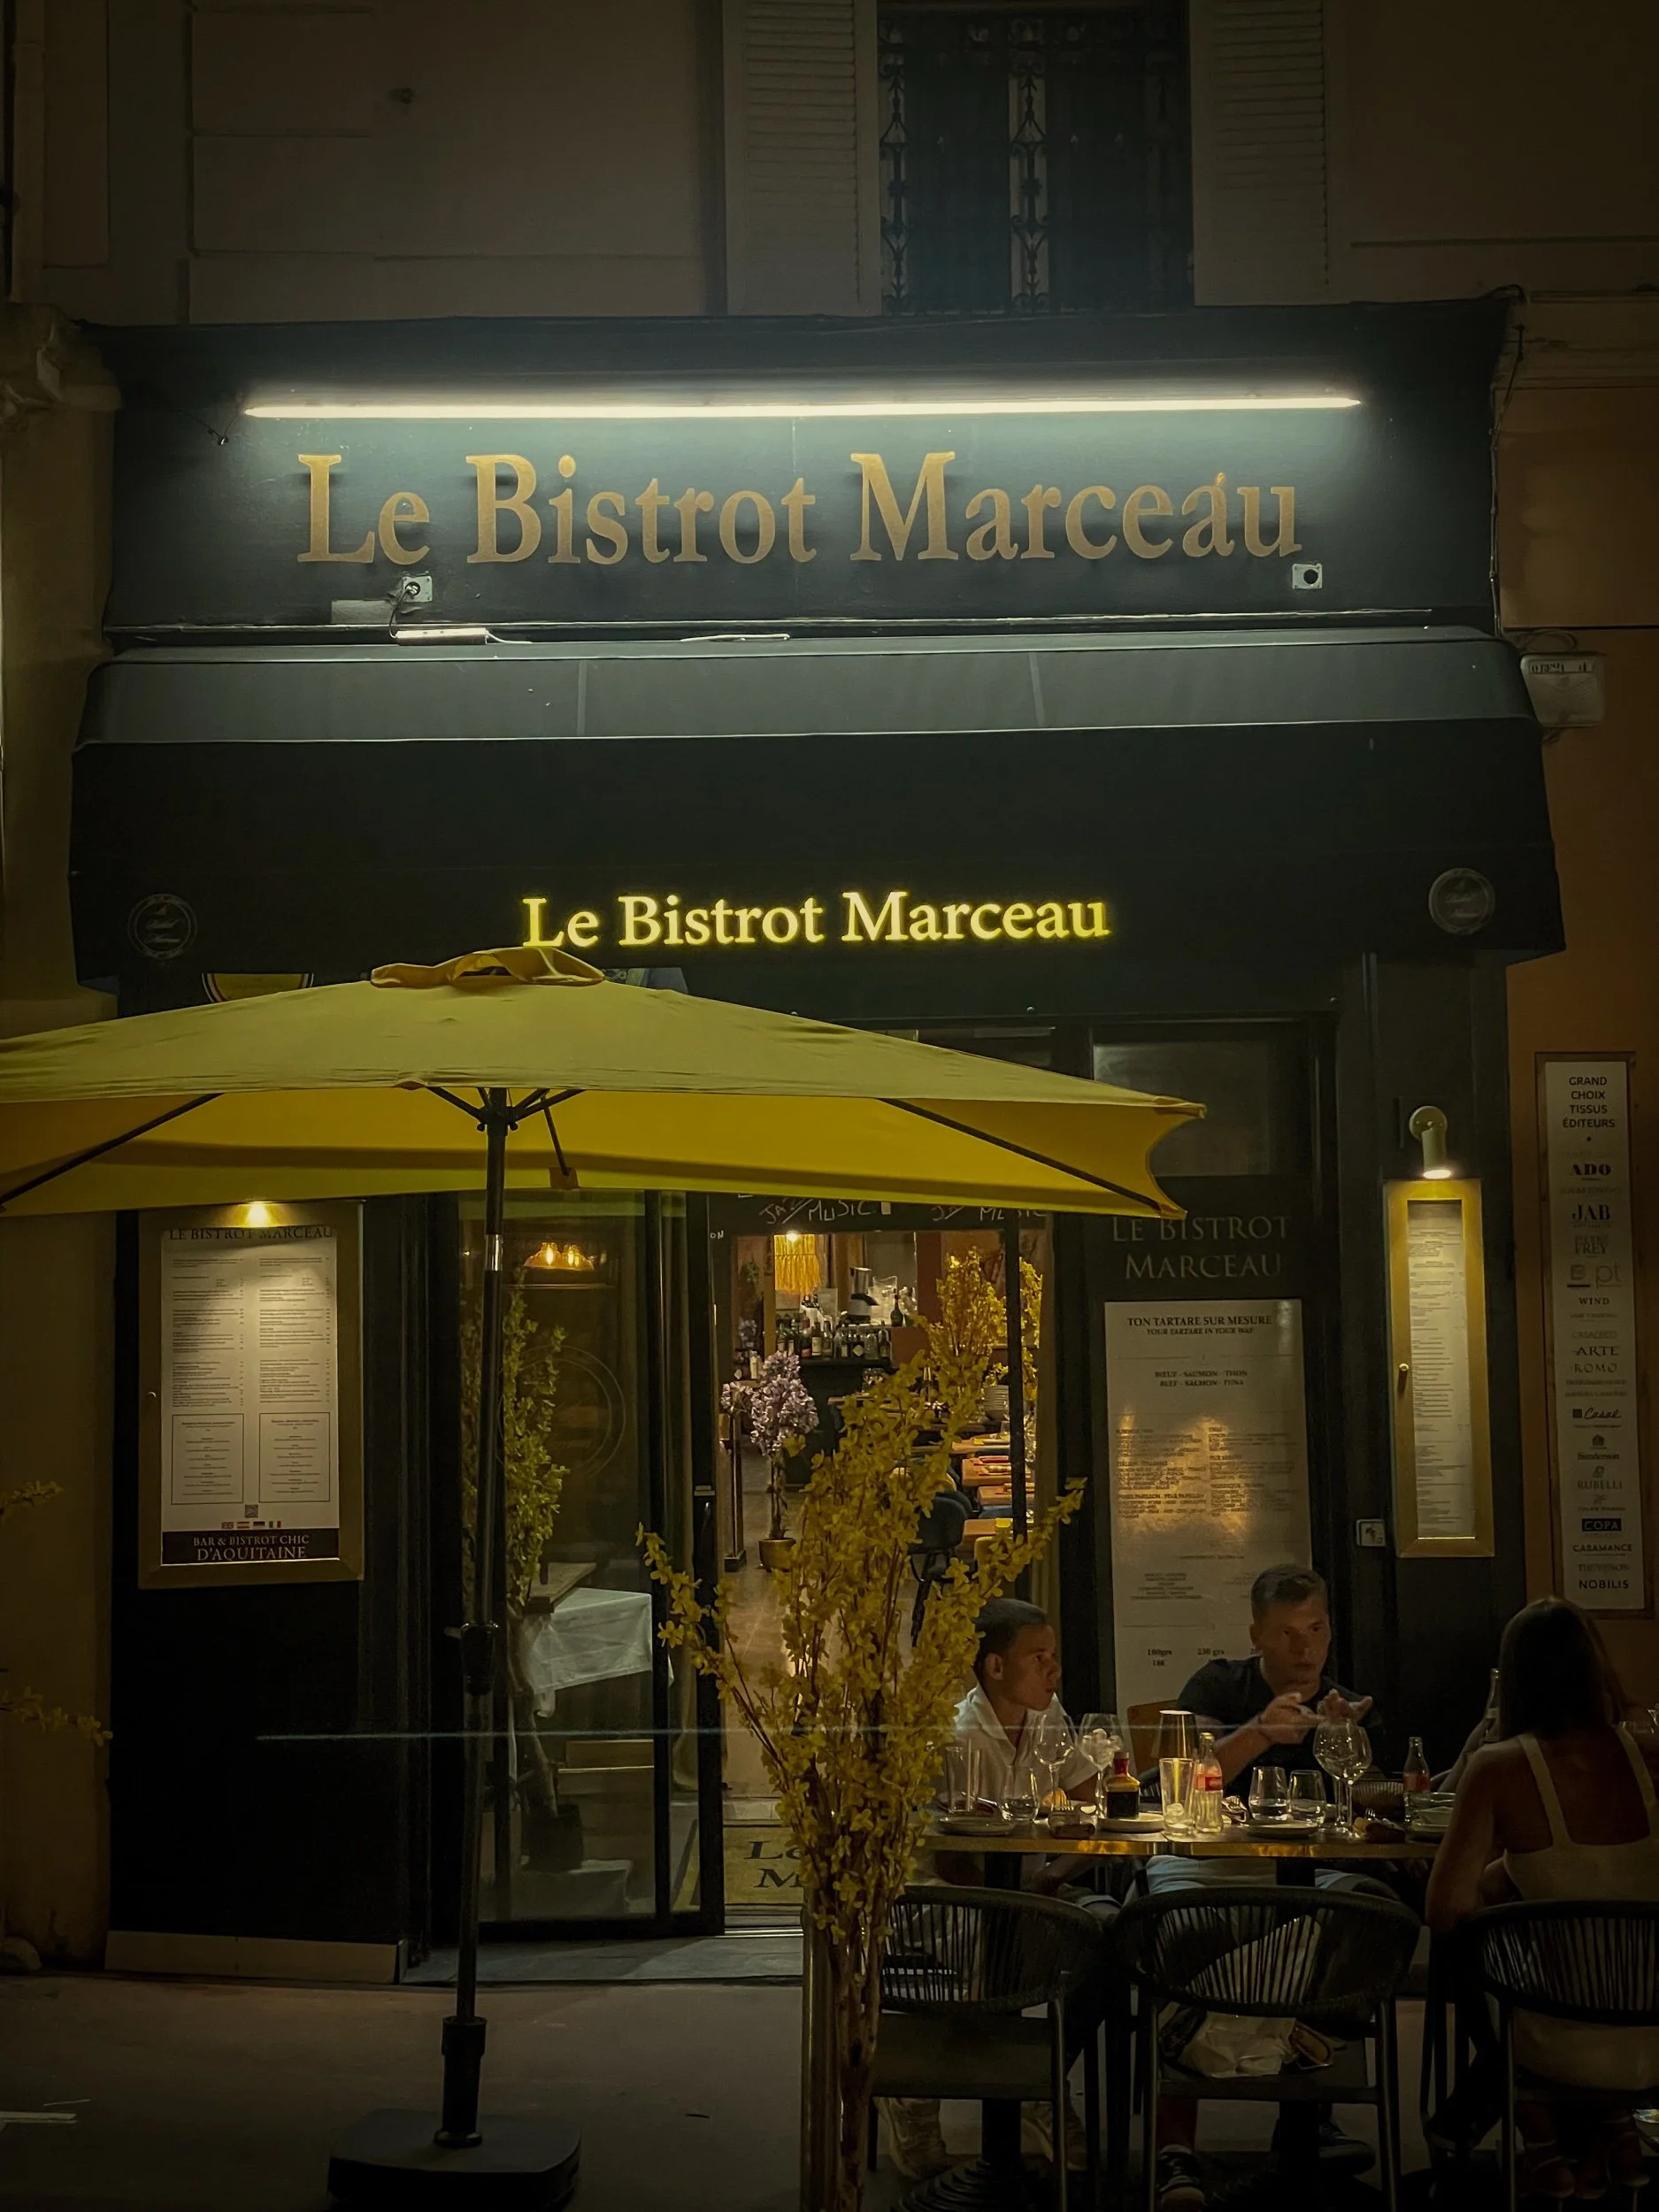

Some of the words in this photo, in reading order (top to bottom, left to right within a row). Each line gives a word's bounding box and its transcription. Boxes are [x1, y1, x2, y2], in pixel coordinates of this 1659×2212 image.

[297, 453, 430, 566] Le
[465, 452, 817, 566] Bistrot
[849, 450, 1303, 562] Marceau
[521, 896, 600, 949] Le
[618, 894, 825, 946] Bistrot
[841, 889, 1110, 941] Marceau
[1569, 1076, 1608, 1086] GRAND
[1571, 1090, 1606, 1100] CHOIX
[1570, 1104, 1608, 1114] TISSUS
[1563, 1117, 1616, 1128] ÉDITEURS
[1571, 1164, 1612, 1176] ADO
[1571, 1203, 1611, 1221] JAB
[169, 1229, 186, 1240] LE
[191, 1227, 252, 1240] BISTROT
[259, 1225, 334, 1240] MARCEAU
[1112, 1216, 1145, 1243] LE
[1159, 1215, 1292, 1241] BISTROT
[1125, 1252, 1282, 1279] MARCEAU
[1578, 1296, 1610, 1305] WIND
[1126, 1317, 1151, 1327] TON
[1153, 1316, 1201, 1326] TARTARE
[1203, 1316, 1225, 1325] SUR
[1227, 1315, 1273, 1325] MESURE
[1574, 1363, 1617, 1373] ROMO
[1577, 1479, 1623, 1490] RUBELLI
[1583, 1520, 1619, 1530] COPA
[193, 1536, 216, 1547] BAR
[218, 1536, 227, 1547] &
[228, 1535, 278, 1547] BISTROT
[279, 1534, 310, 1545] CHIC
[196, 1546, 308, 1562] D'AQUITAINE
[1572, 1543, 1632, 1553] CASAMANCE
[1578, 1578, 1629, 1590] NOBILIS
